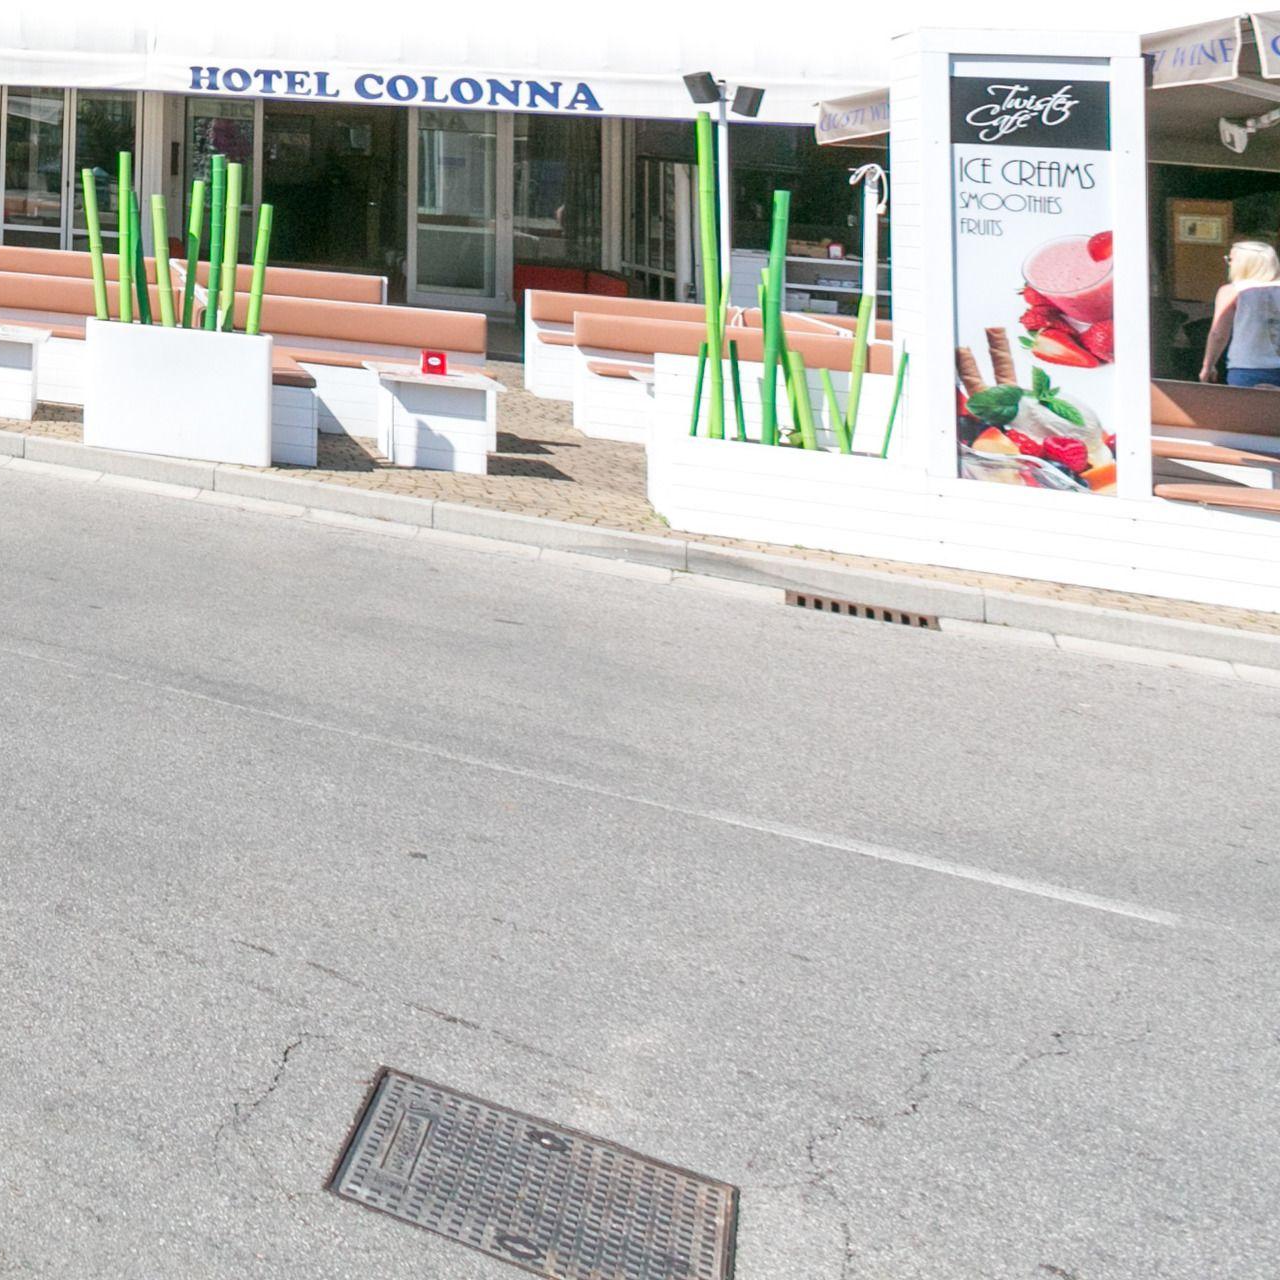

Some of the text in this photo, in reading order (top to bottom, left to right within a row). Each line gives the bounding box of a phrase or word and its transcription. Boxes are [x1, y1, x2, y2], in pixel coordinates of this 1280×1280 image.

[1172, 37, 1234, 67] WINE
[189, 65, 604, 111] HOTEL COLONNA
[987, 84, 1080, 125] Twister
[959, 156, 1095, 189] ICE CREAMS
[959, 191, 1063, 214] SMOOTHIES
[959, 217, 1004, 237] FRUITS
